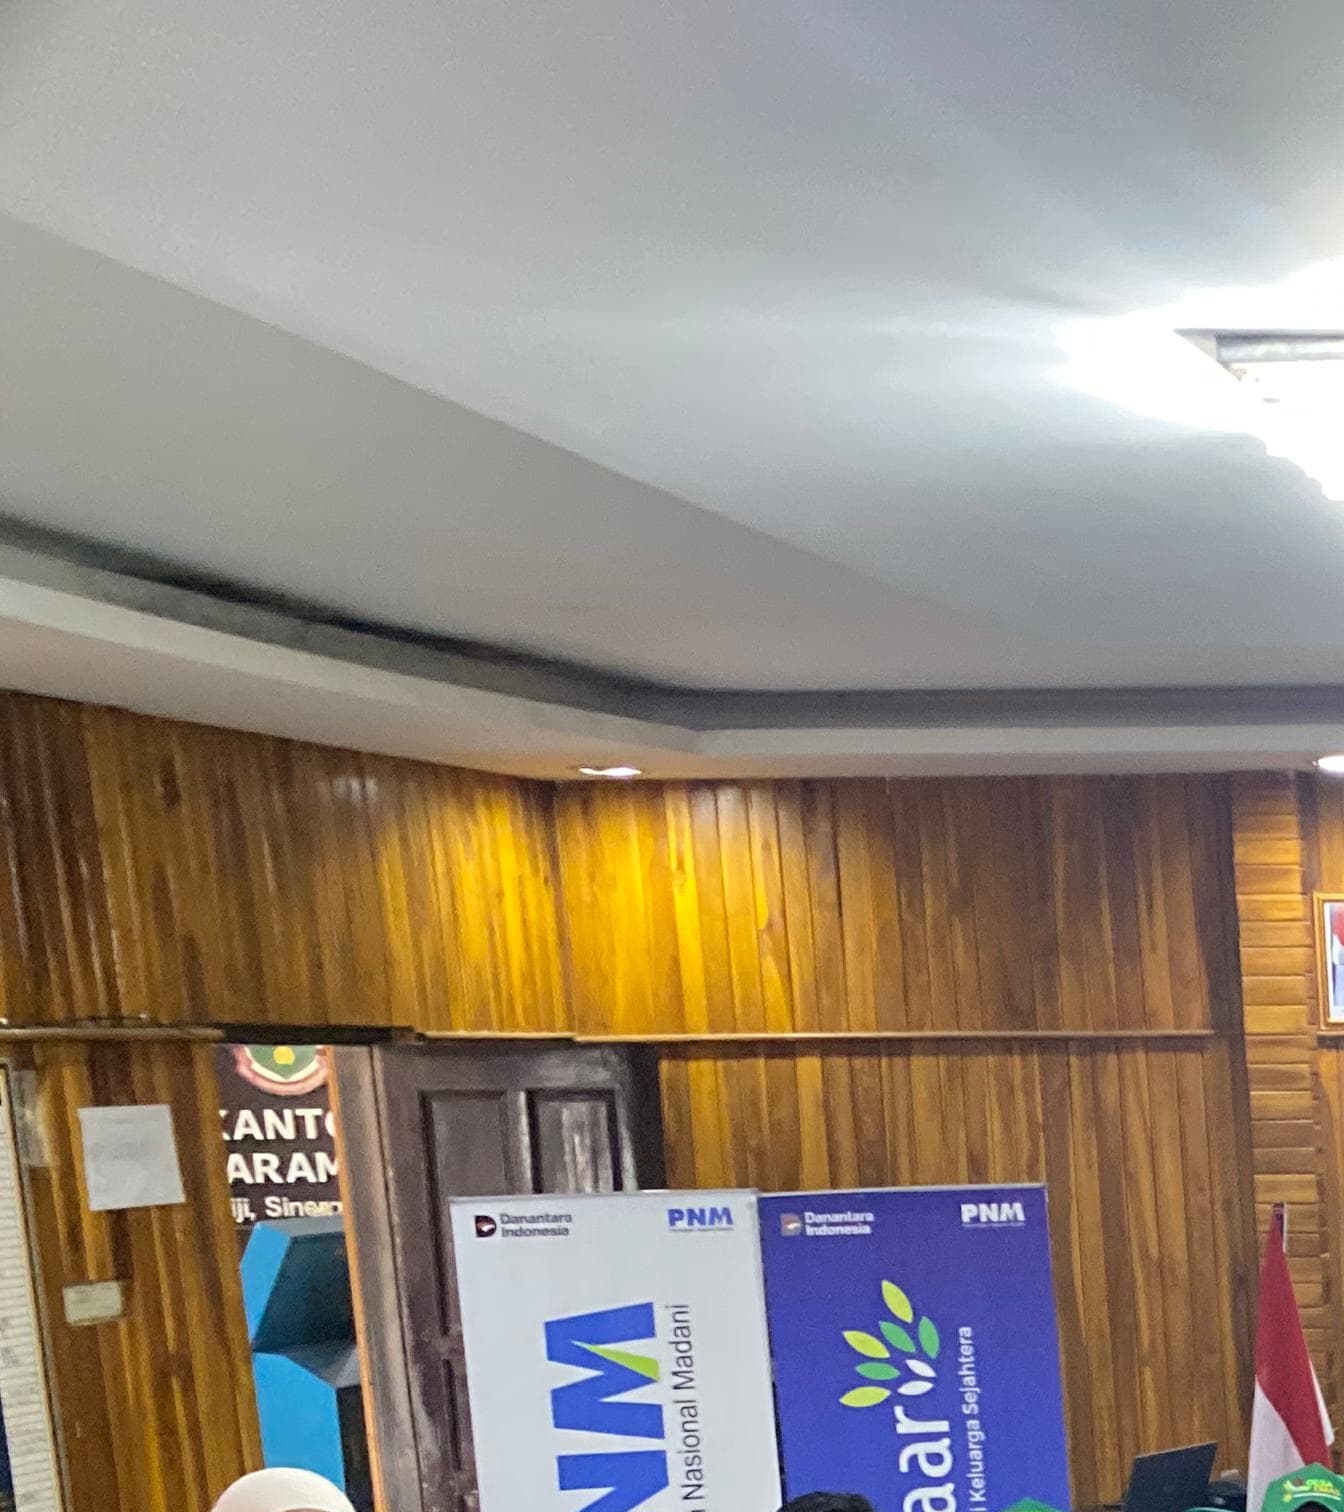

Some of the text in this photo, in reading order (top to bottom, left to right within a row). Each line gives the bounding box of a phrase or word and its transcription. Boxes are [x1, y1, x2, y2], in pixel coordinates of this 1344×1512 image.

[500, 1211, 573, 1225] Danantara
[667, 1208, 734, 1227] PNM
[804, 1211, 875, 1224] Danantara
[961, 1203, 1025, 1223] PNM
[500, 1225, 570, 1238] Indonesia
[805, 1223, 871, 1236] Indonesia
[665, 1303, 697, 1391] Madani
[957, 1326, 978, 1417] Sejahtera
[676, 1400, 707, 1501] Nasional
[966, 1419, 988, 1502] Keluarga
